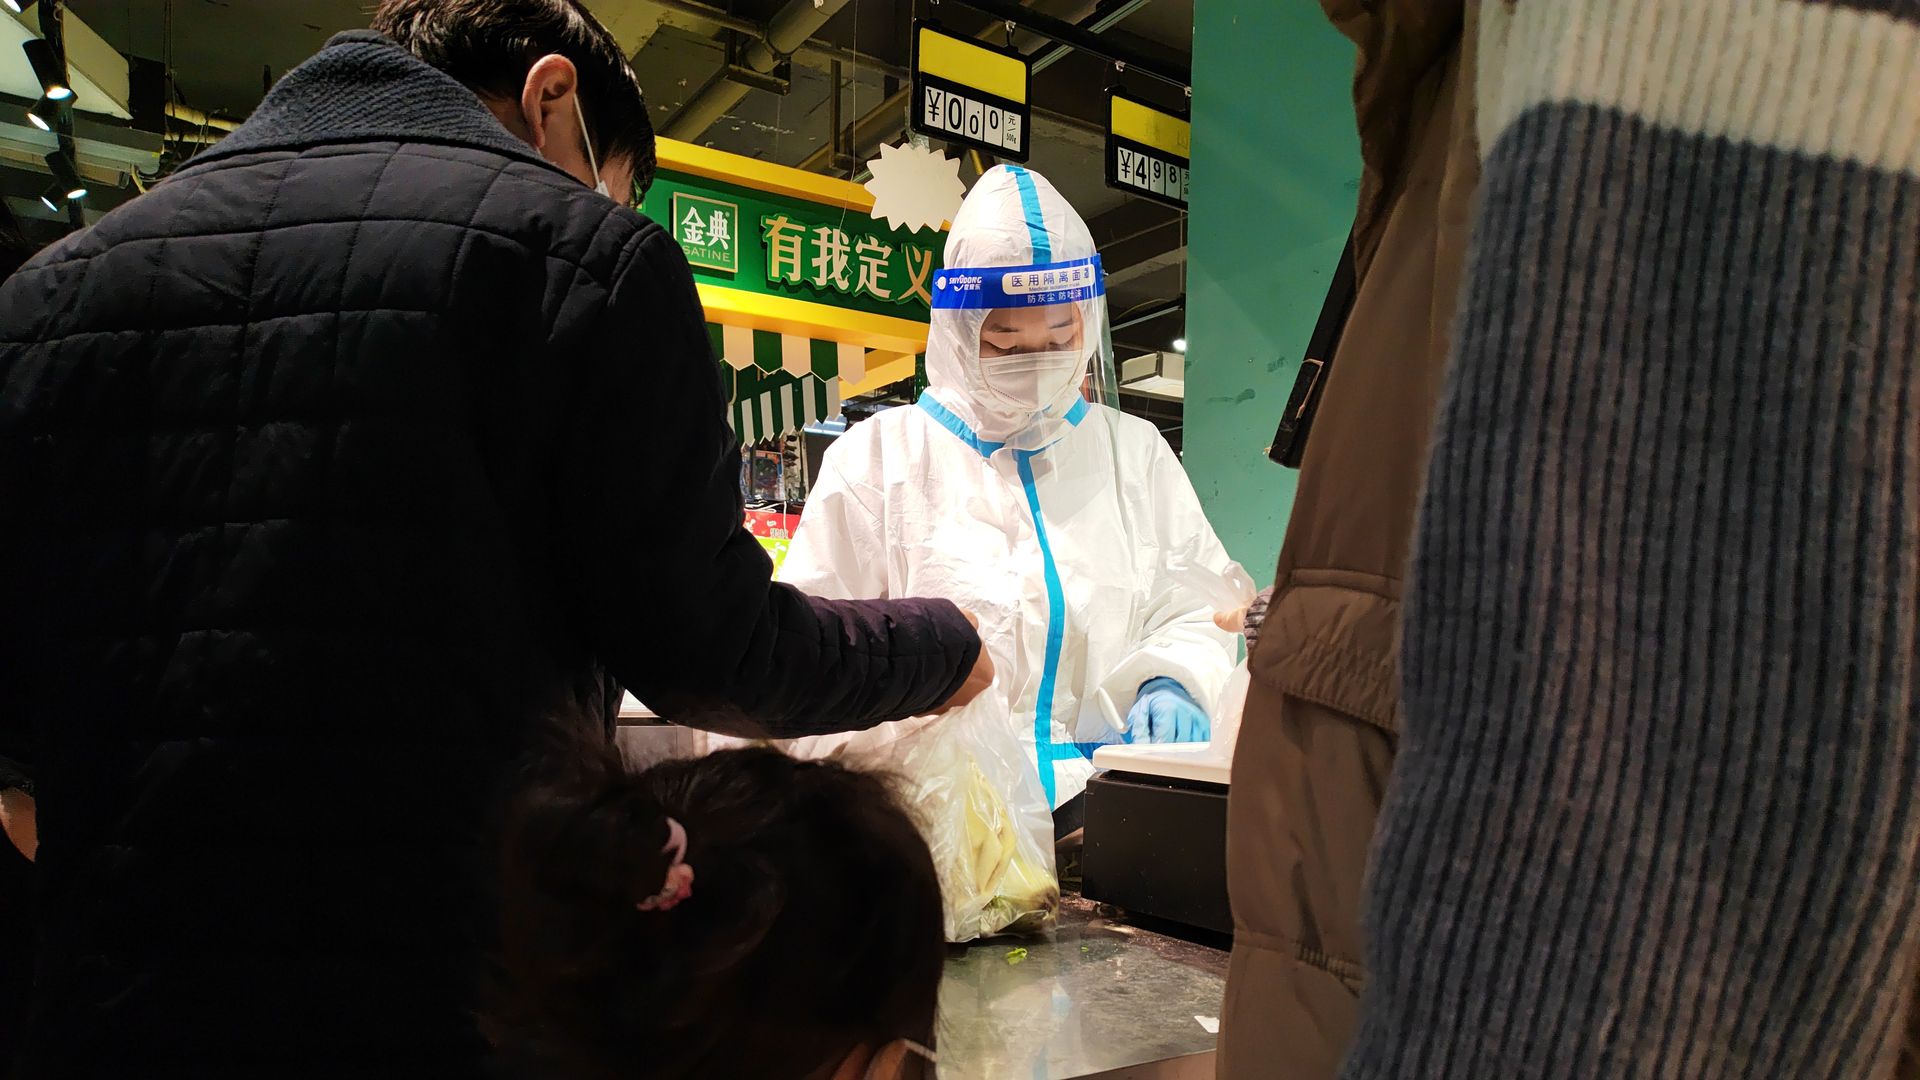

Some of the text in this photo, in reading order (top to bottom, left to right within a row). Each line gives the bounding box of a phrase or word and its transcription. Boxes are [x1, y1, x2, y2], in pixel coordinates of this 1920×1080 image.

[681, 207, 731, 250] 金典
[683, 245, 730, 263] SATINE
[765, 216, 932, 305] 有我定义
